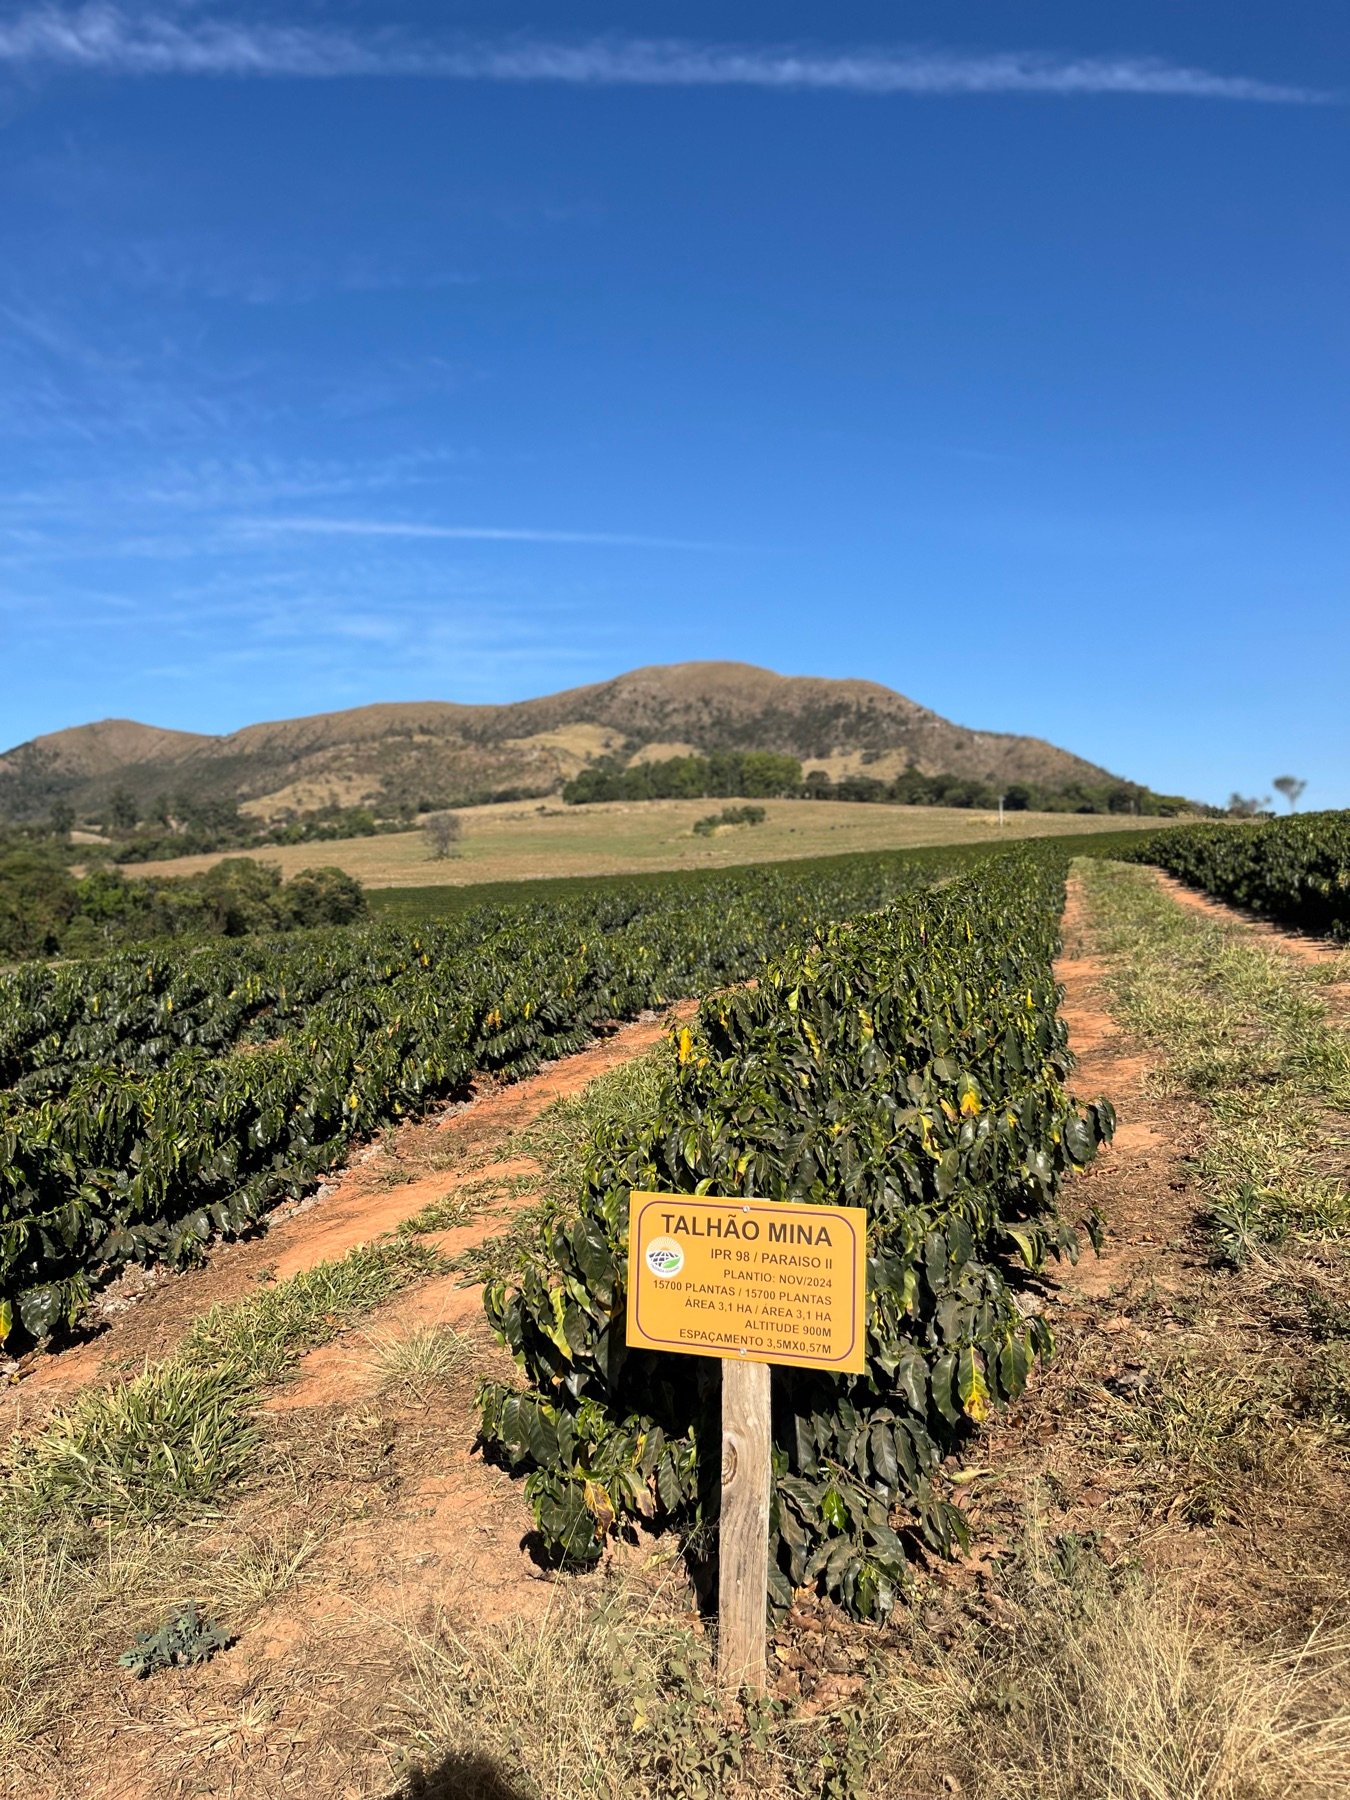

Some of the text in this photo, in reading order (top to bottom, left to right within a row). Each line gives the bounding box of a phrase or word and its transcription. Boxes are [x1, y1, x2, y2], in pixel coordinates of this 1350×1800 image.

[661, 1214, 832, 1246] TALHÃO MINA
[711, 1249, 731, 1260] IPR
[736, 1251, 750, 1261] 98
[762, 1253, 821, 1268] PARAISO
[826, 1259, 832, 1269] II
[724, 1270, 832, 1288] PLANTIO: NOV/2024
[654, 1280, 682, 1291] 15700
[686, 1283, 735, 1296] PLANTAS
[746, 1289, 775, 1300] 15700
[779, 1292, 832, 1305] PLANTAS
[685, 1296, 715, 1309] ÁREA
[719, 1302, 733, 1312] 3,1
[737, 1304, 752, 1314] HA
[762, 1304, 792, 1318] ÁREA
[797, 1310, 811, 1321] 3,1
[816, 1312, 831, 1322] HA
[745, 1320, 831, 1337] ALTITUDE 900M
[680, 1329, 831, 1354] ESPAÇAMENTO 3,5MX0,57M
